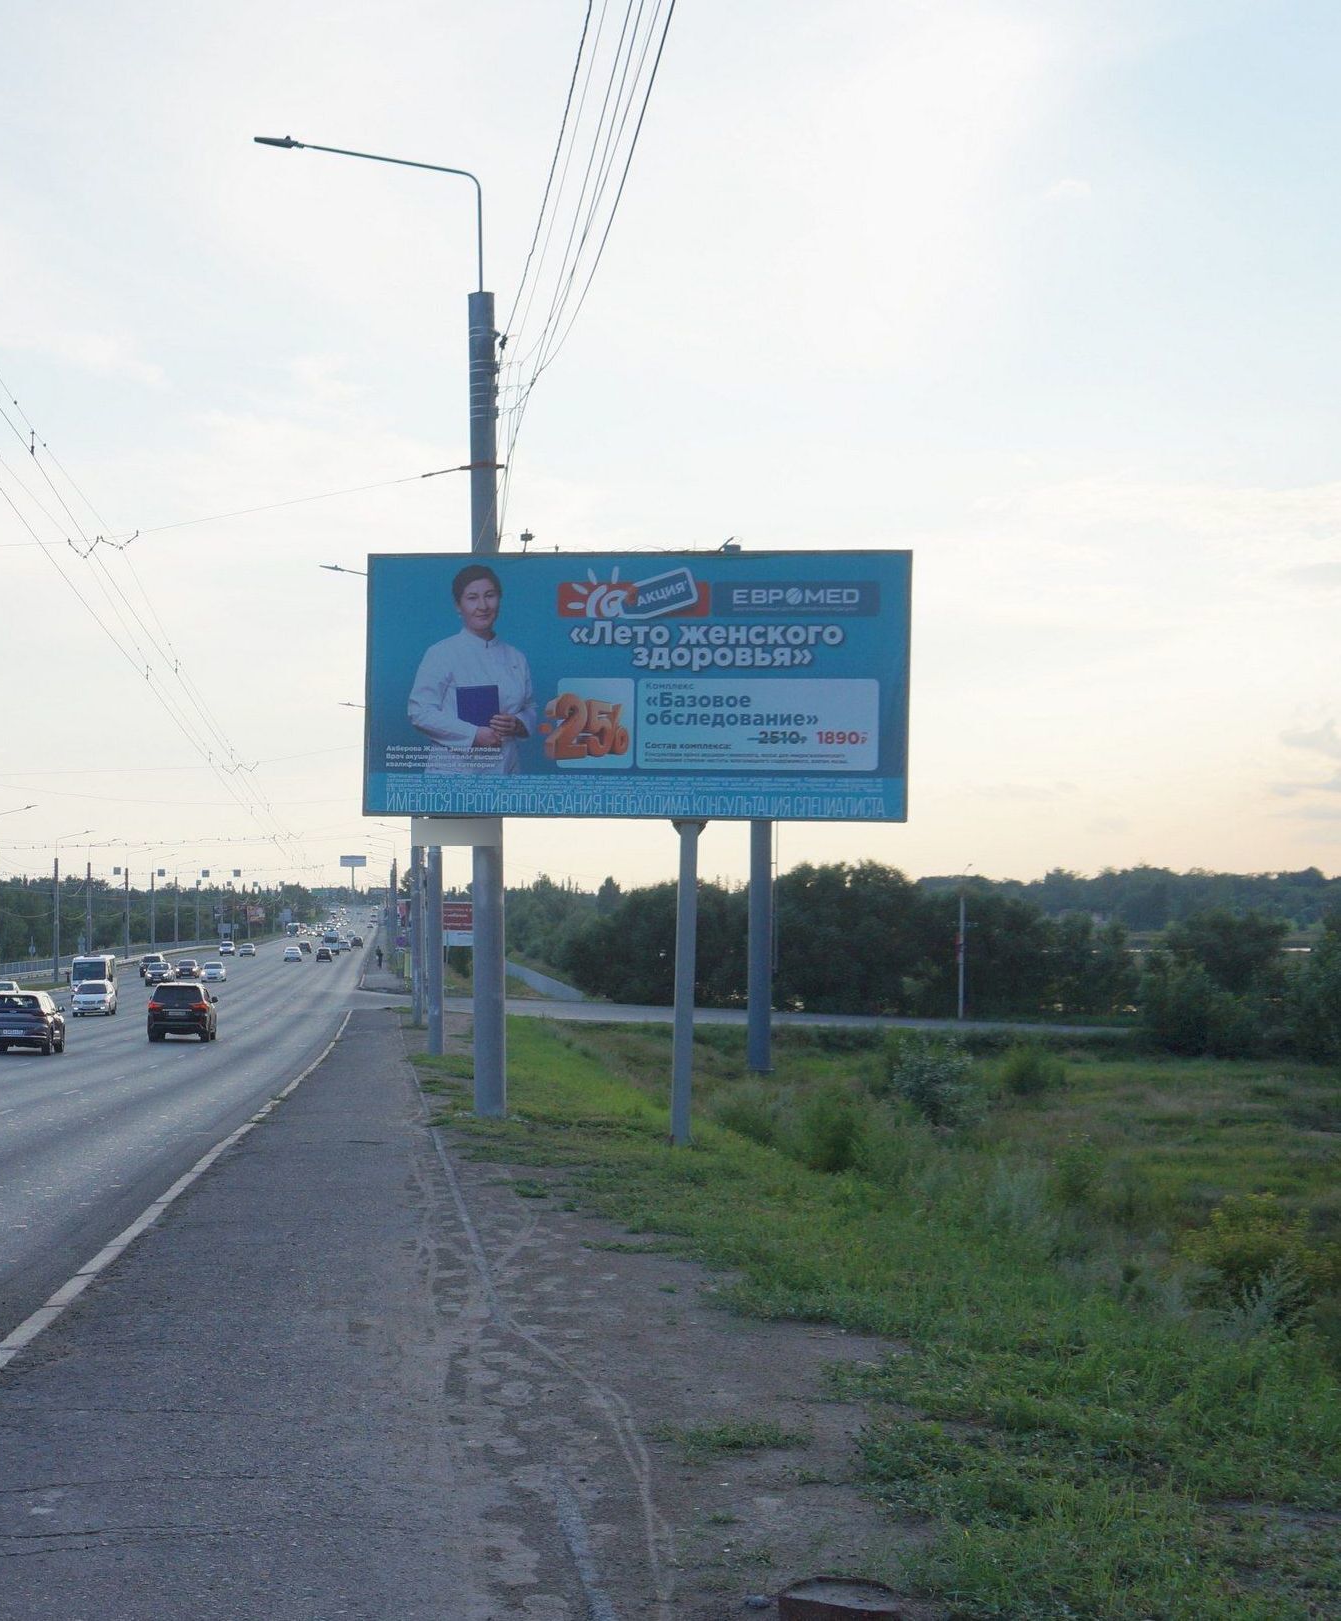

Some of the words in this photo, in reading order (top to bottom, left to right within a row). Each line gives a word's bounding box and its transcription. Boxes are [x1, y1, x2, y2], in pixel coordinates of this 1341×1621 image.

[570, 620, 671, 645] «Лето
[679, 624, 844, 646] женского
[632, 646, 812, 672] здоровья»
[645, 682, 694, 690] Комплекс
[646, 692, 751, 708] «Базовое
[645, 710, 819, 728] обследование»
[679, 742, 732, 750] комплекса:
[387, 791, 452, 812] ИМЕЮТСЯ
[605, 794, 690, 815] НЕОБХОДИМА
[692, 796, 791, 817] КОНСУЛЬТАЦИЯ
[794, 796, 885, 818] СПЕЦИАЛИСТА
